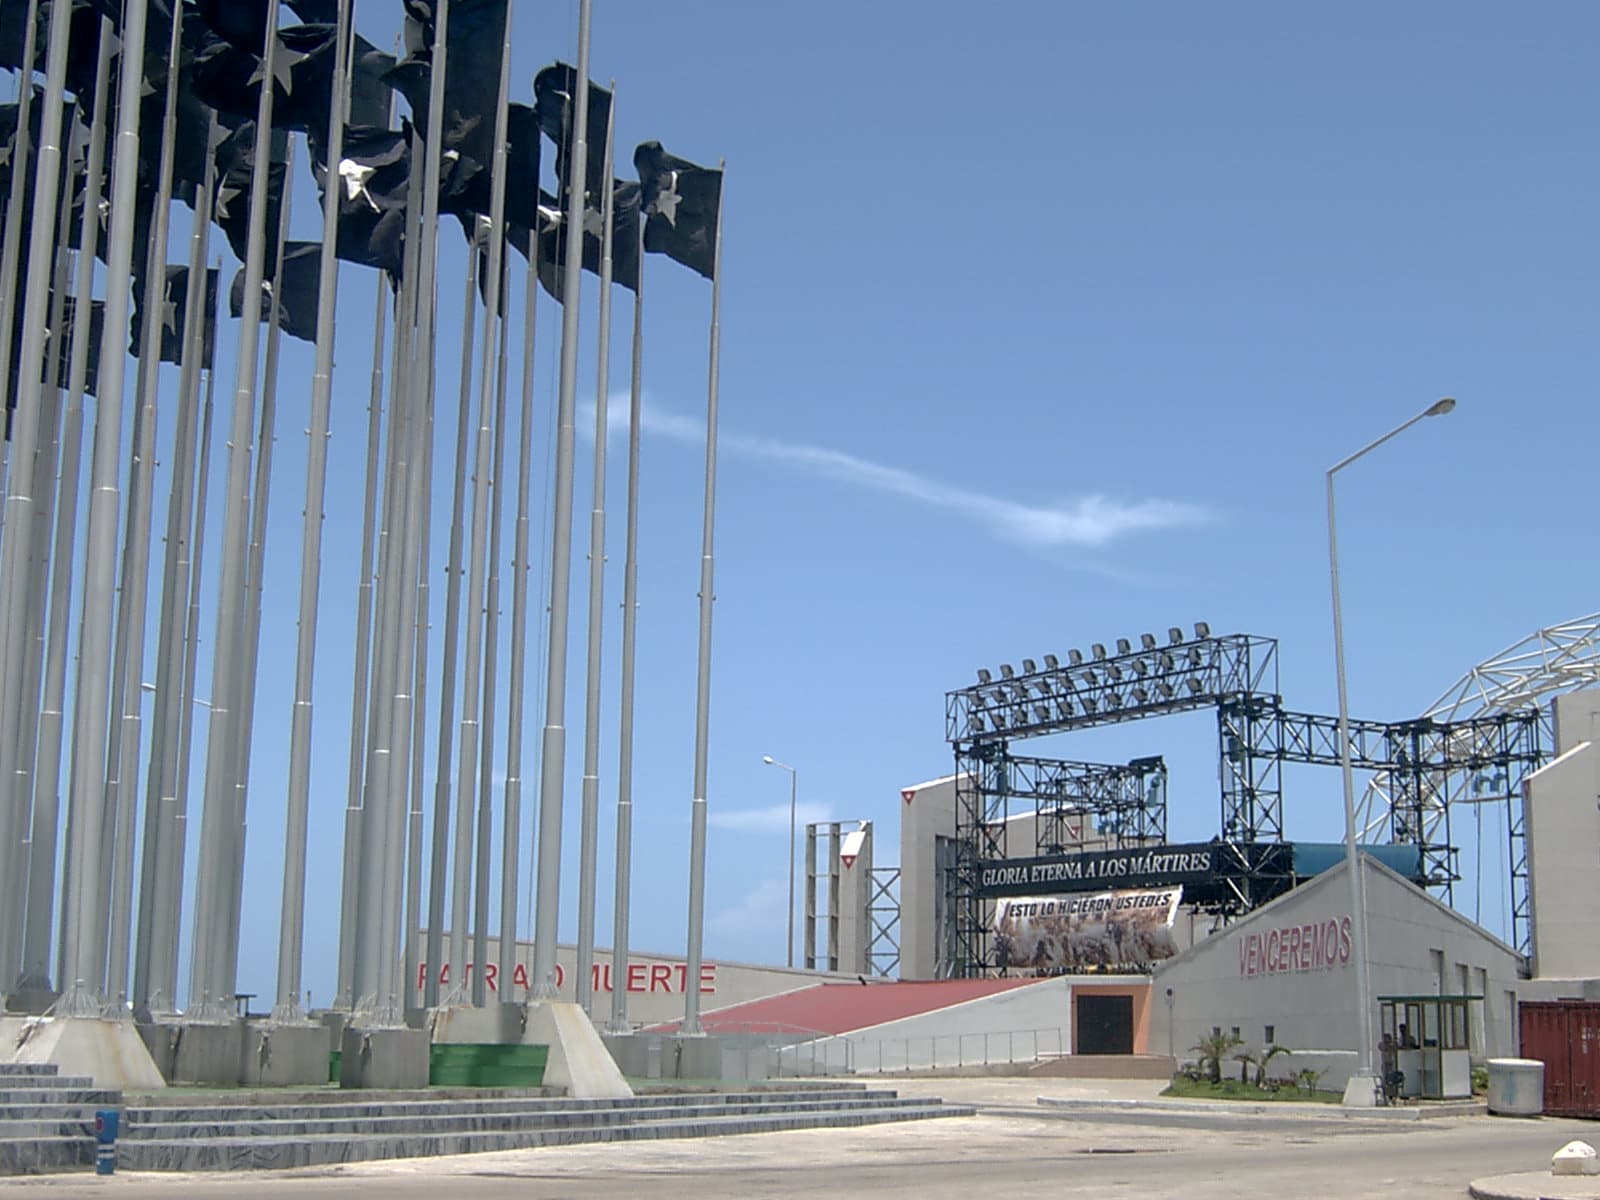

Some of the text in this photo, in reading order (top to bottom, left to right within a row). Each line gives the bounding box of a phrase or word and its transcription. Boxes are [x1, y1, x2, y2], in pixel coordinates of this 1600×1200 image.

[982, 850, 1212, 886] GLORIA ETERNA A LOS MÁRTIRES
[1009, 902, 1038, 918] ESTO
[1040, 902, 1056, 916] LO
[1115, 893, 1172, 910] USTEDES
[1239, 914, 1353, 977] VENCEREMOS
